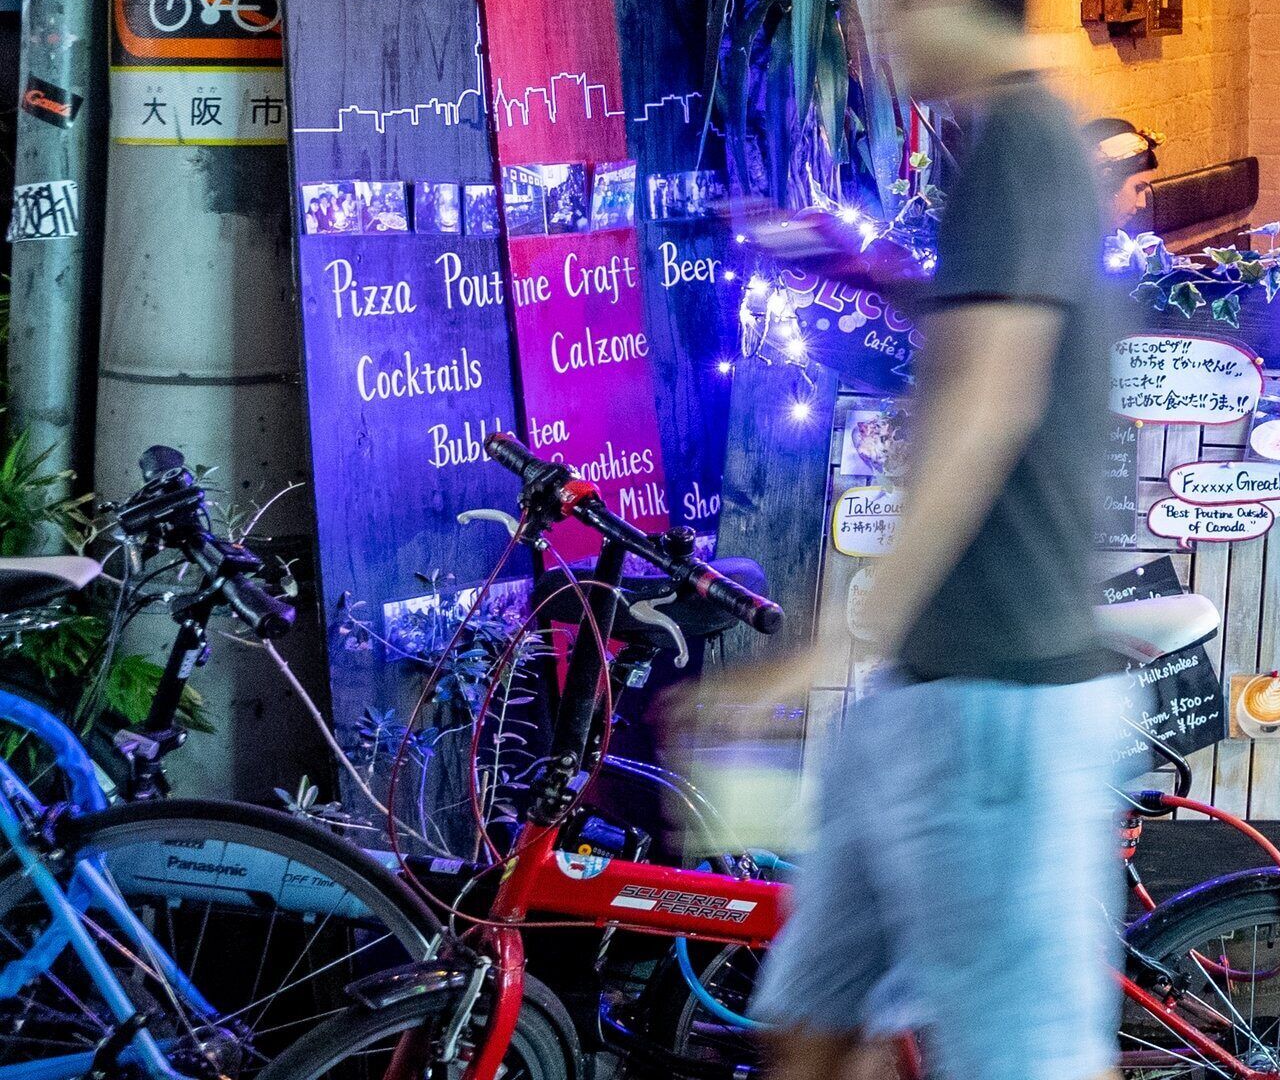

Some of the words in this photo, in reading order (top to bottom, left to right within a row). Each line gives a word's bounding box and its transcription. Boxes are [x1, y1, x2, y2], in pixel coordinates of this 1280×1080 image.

[141, 96, 284, 127] 大阪市
[325, 258, 417, 319] Pizza
[564, 252, 637, 304] Craft
[658, 241, 721, 289] Beer
[551, 327, 650, 374] Calzone
[356, 346, 484, 402] Cocktails
[530, 418, 570, 451] tea
[618, 482, 670, 520] Milk
[1188, 521, 1201, 534] of
[1138, 654, 1200, 688] Milkshakes
[167, 855, 248, 877] Panasonic
[619, 884, 729, 909] SCUDERIA
[655, 902, 750, 923] FERRARI
